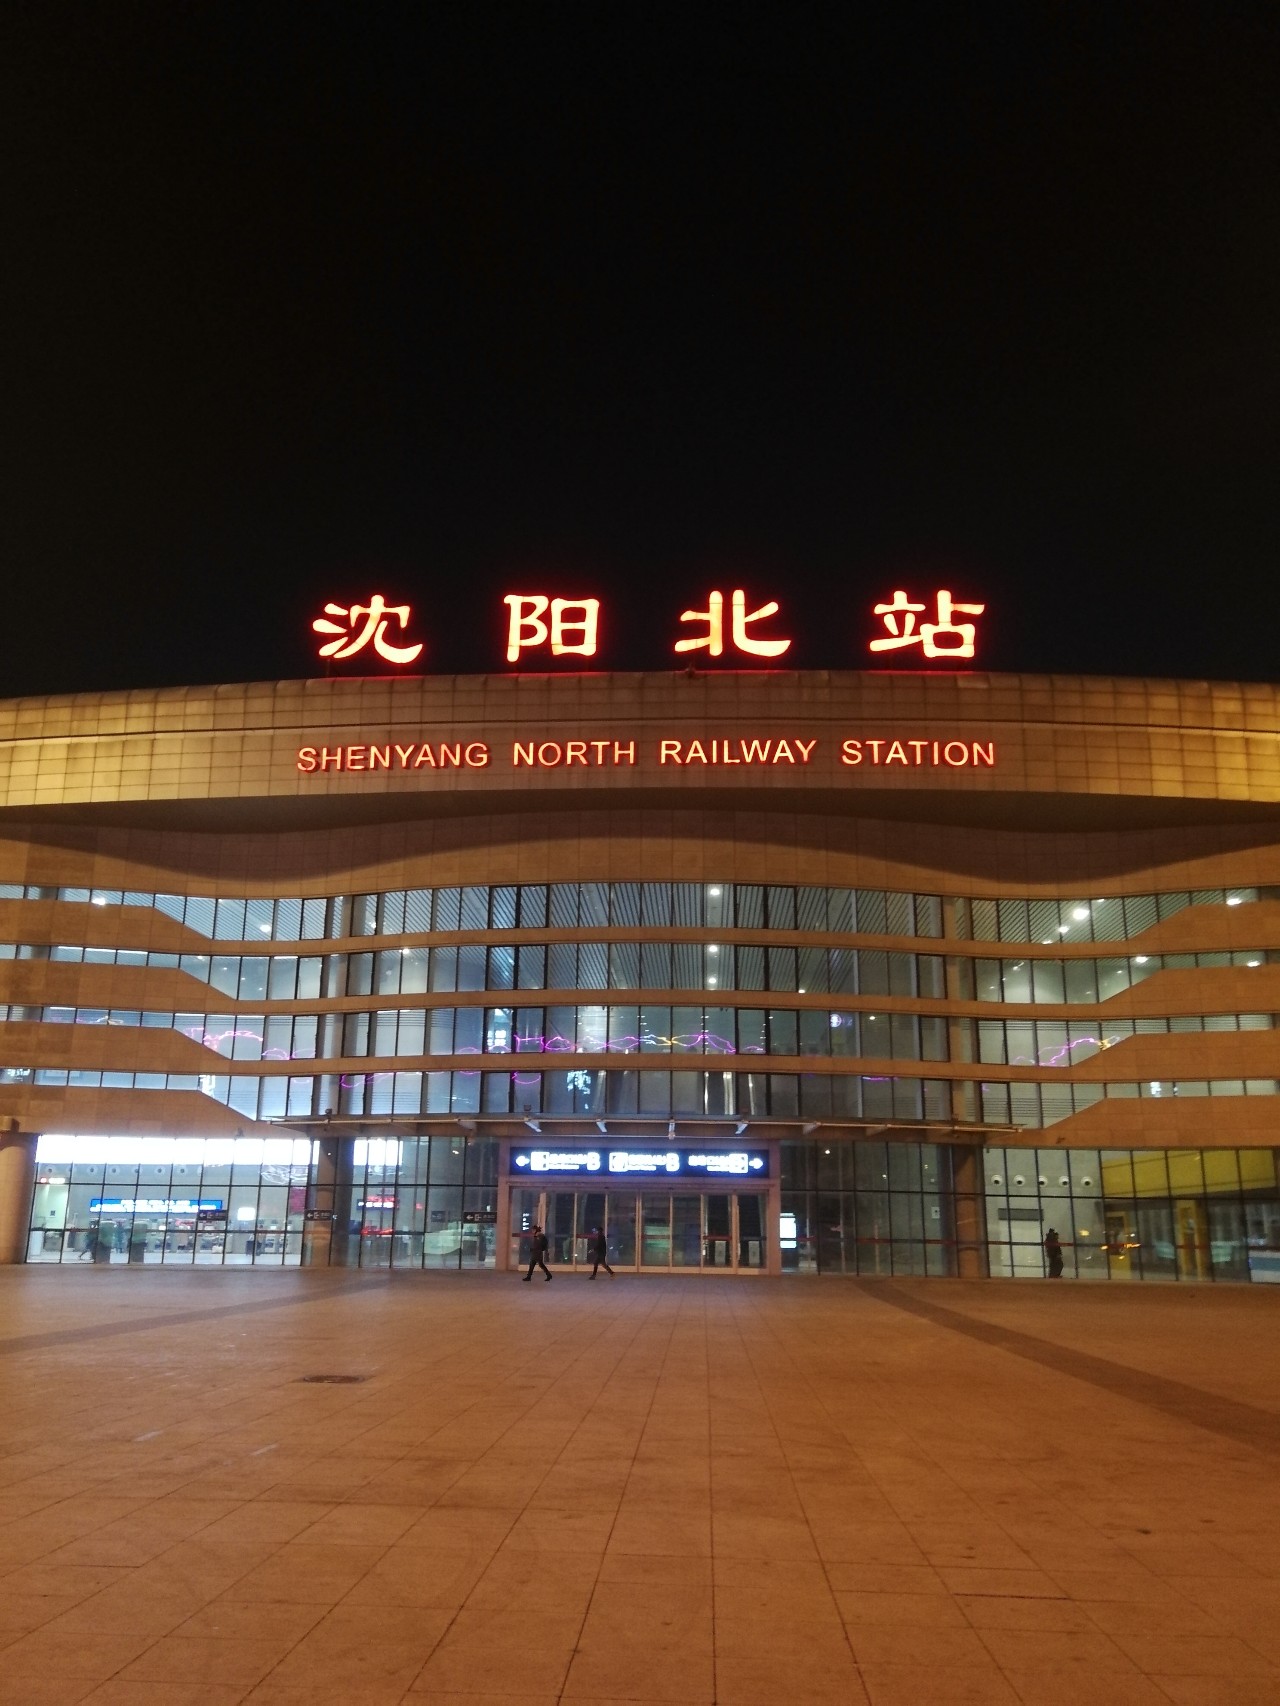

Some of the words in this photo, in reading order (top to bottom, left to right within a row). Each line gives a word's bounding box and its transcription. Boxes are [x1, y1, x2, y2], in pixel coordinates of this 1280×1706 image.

[312, 589, 985, 663] 沈阳北站
[297, 743, 488, 771] SHENYANG
[512, 740, 635, 766] NORTH
[660, 739, 817, 764] RAILWAY
[841, 739, 995, 767] STATION
